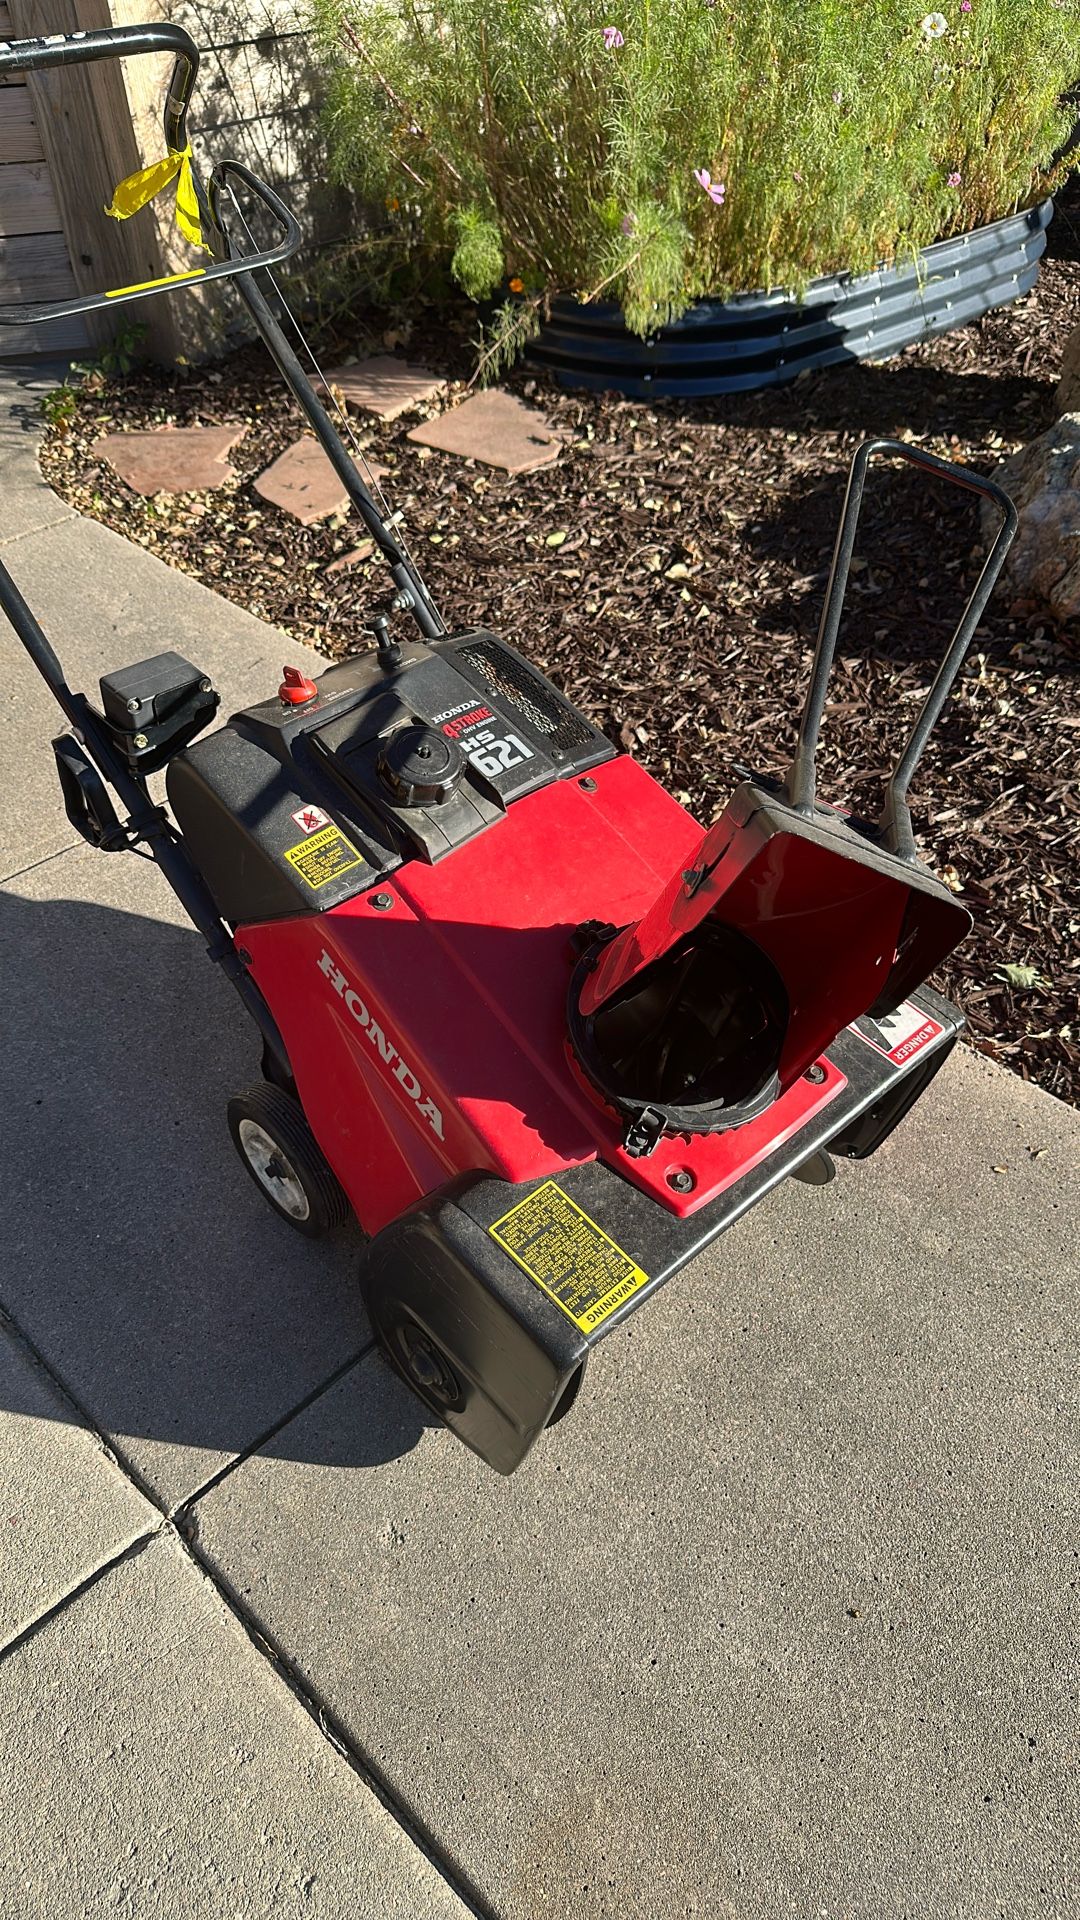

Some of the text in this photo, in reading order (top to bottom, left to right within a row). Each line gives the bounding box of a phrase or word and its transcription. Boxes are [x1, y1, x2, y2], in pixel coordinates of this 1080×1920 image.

[431, 699, 481, 724] HONDA
[463, 716, 497, 734] OHV ENGINE
[459, 729, 496, 753] HS
[468, 734, 535, 777] 621
[296, 828, 337, 854] WARNING
[317, 948, 446, 1142] HONDA
[894, 1033, 928, 1060] DANGER
[585, 1282, 631, 1324] WARNING
